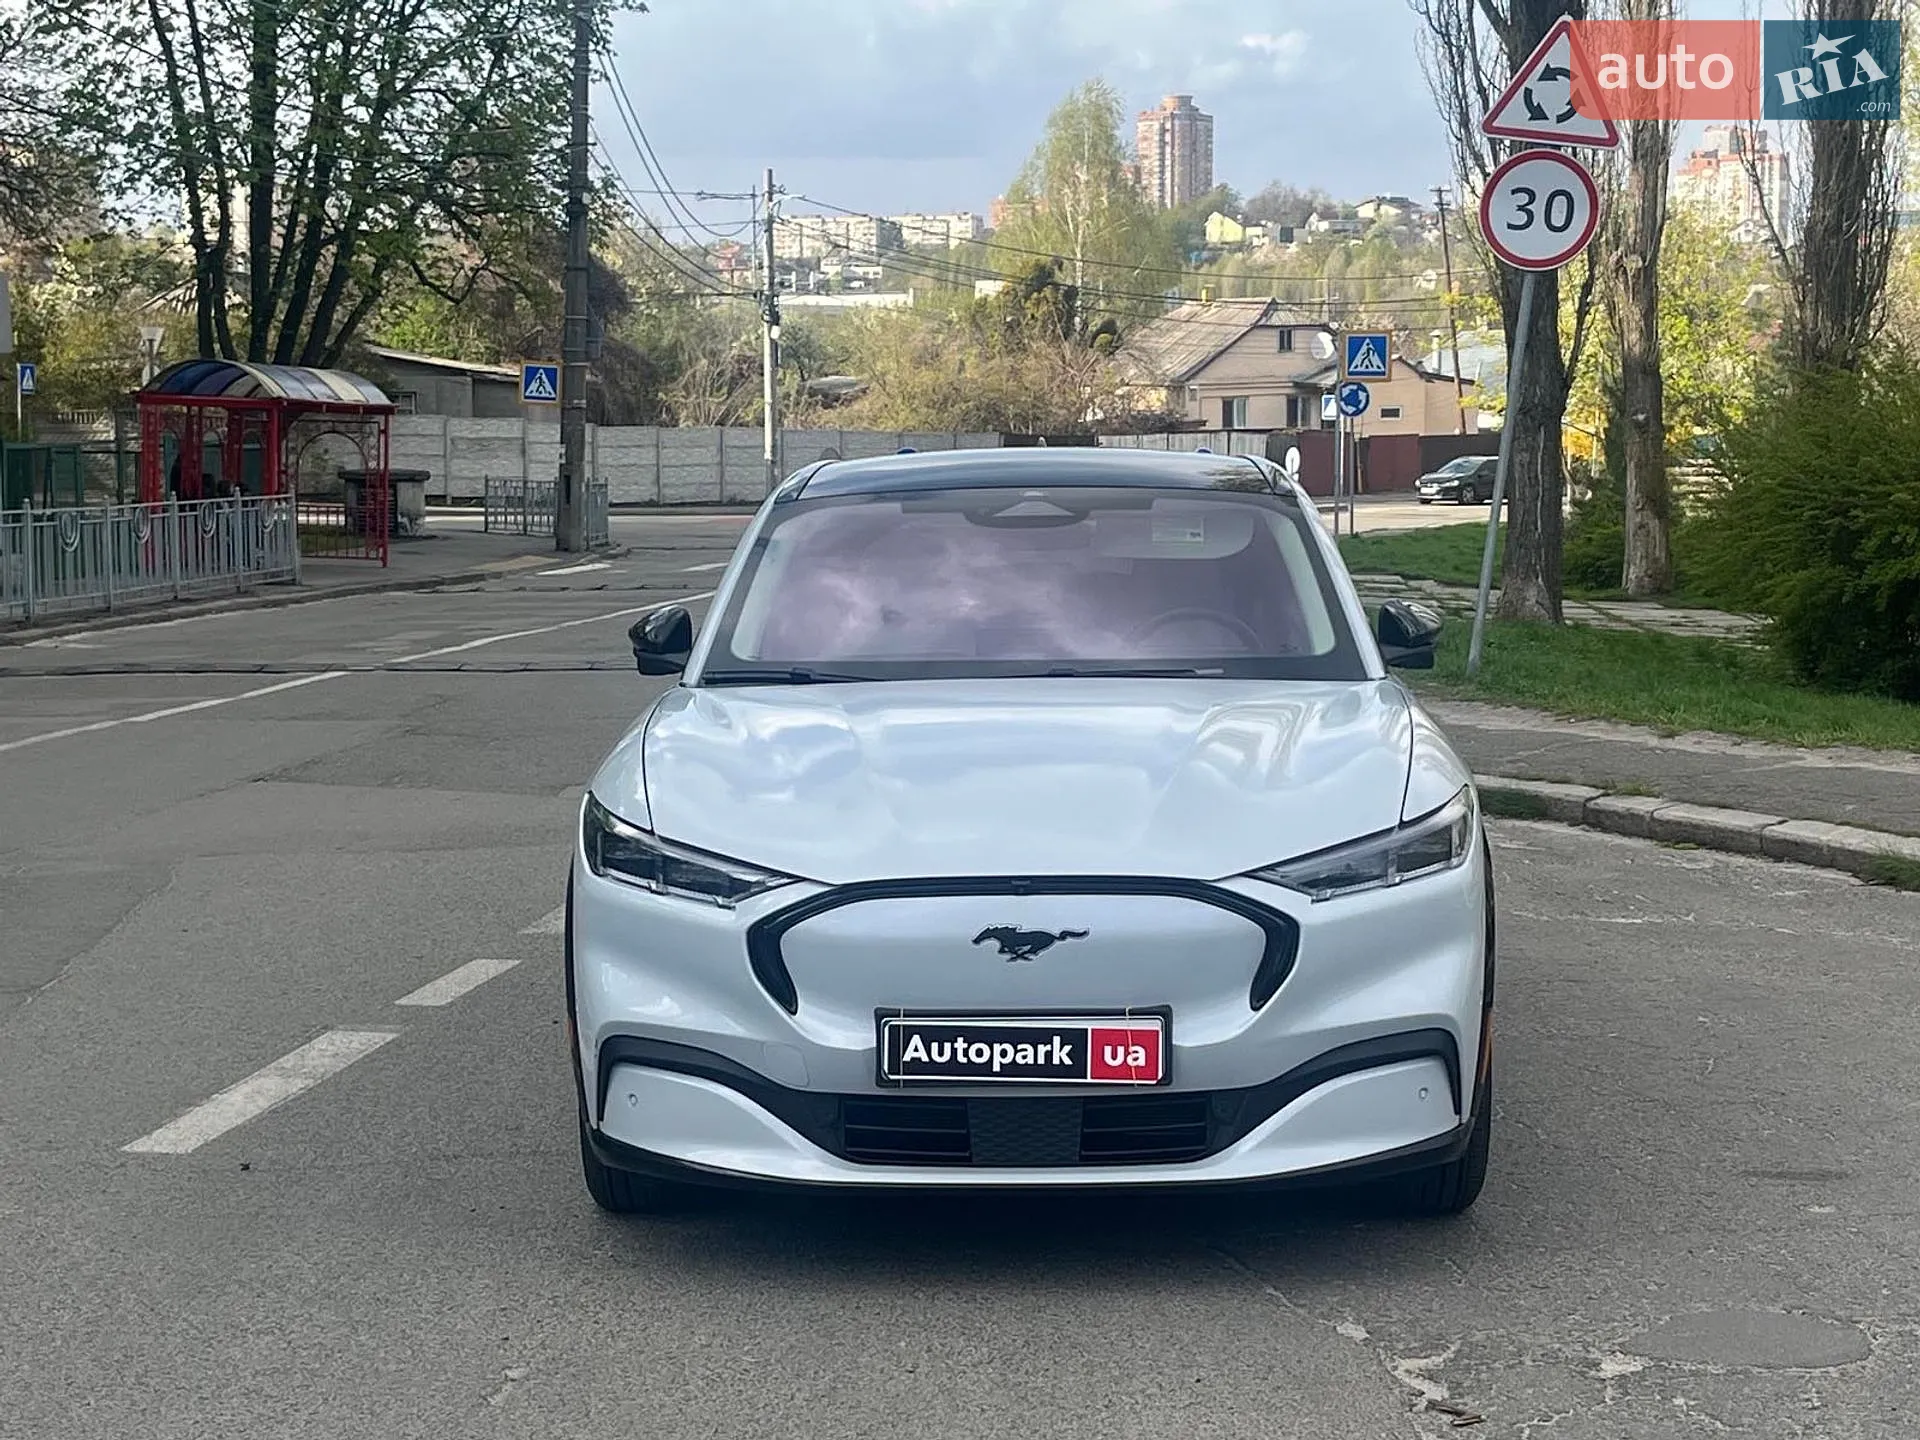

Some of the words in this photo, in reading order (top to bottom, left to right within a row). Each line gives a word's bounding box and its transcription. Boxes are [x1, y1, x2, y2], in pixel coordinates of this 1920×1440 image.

[1506, 186, 1575, 233] 30
[902, 1034, 1073, 1072] Autopark
[1103, 1045, 1146, 1067] ua
